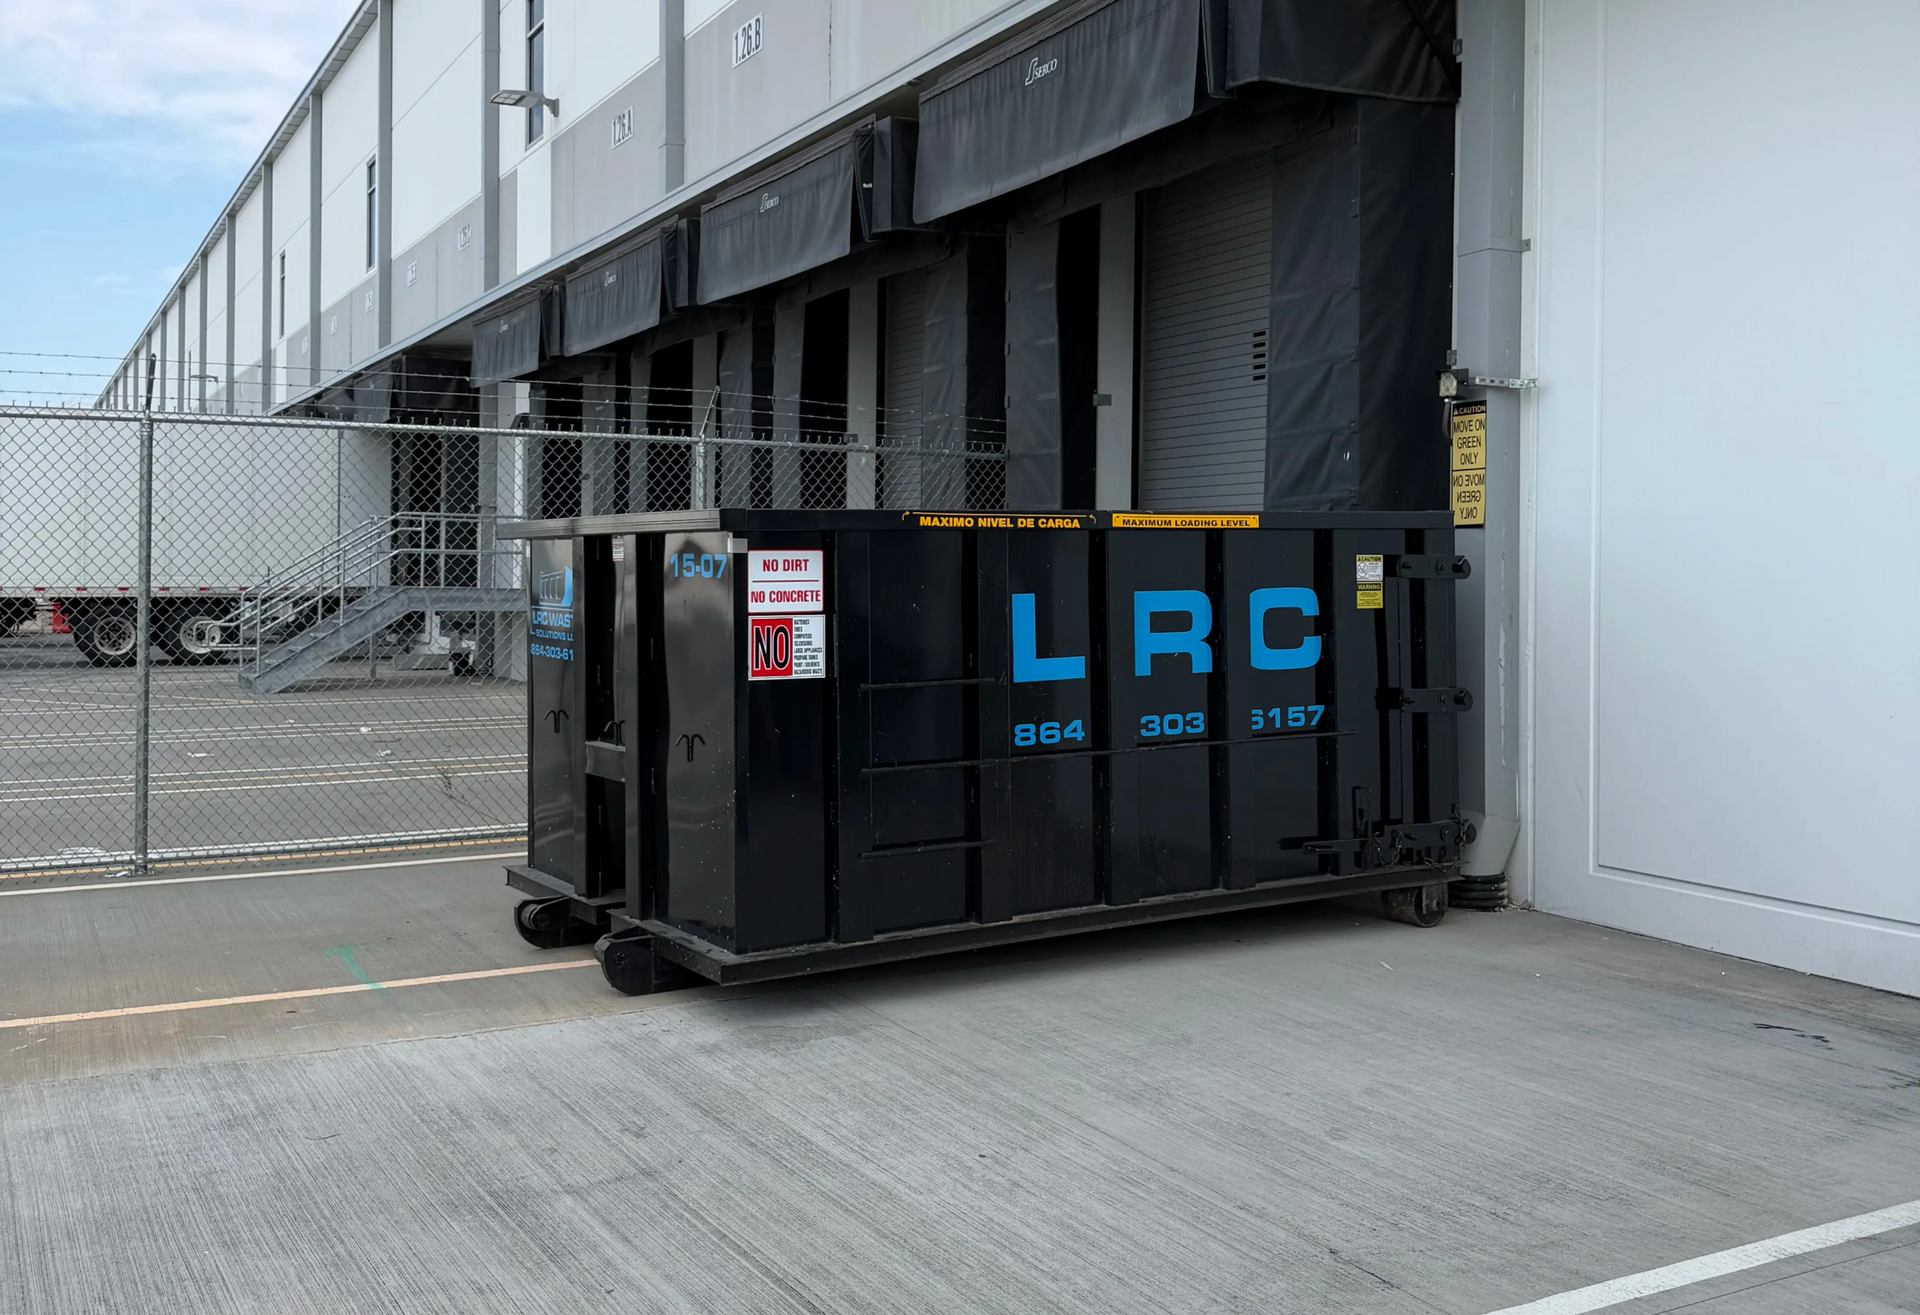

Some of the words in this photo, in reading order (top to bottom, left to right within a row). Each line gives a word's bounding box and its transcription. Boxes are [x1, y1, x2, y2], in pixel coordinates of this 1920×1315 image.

[734, 17, 761, 64] 1.26.B
[612, 109, 632, 147] 1.26.A
[1459, 405, 1486, 415] CAUTION
[1453, 419, 1473, 433] MOVE
[1475, 418, 1485, 431] ON
[1456, 435, 1481, 449] GREEN
[1460, 452, 1479, 465] ONLY
[919, 516, 974, 528] MAXIMO
[978, 517, 1014, 528] NIVEL
[1017, 518, 1035, 528] DE
[1038, 518, 1080, 529] CARGA
[1122, 518, 1172, 527] MAXIMUM
[1175, 519, 1218, 527] LOADING
[1220, 519, 1250, 527] LEVEL
[670, 553, 727, 578] 15-07
[762, 559, 779, 572] NO
[782, 558, 809, 572] DIRT
[750, 590, 766, 603] NO
[769, 590, 821, 603] CONCRETE
[532, 610, 548, 625] LRC
[549, 612, 574, 628] WAS
[536, 628, 566, 640] SOLUTIONS
[530, 643, 574, 661] 864-303-61
[754, 624, 790, 671] NO
[1014, 719, 1085, 746] 864
[1140, 712, 1205, 737] 303
